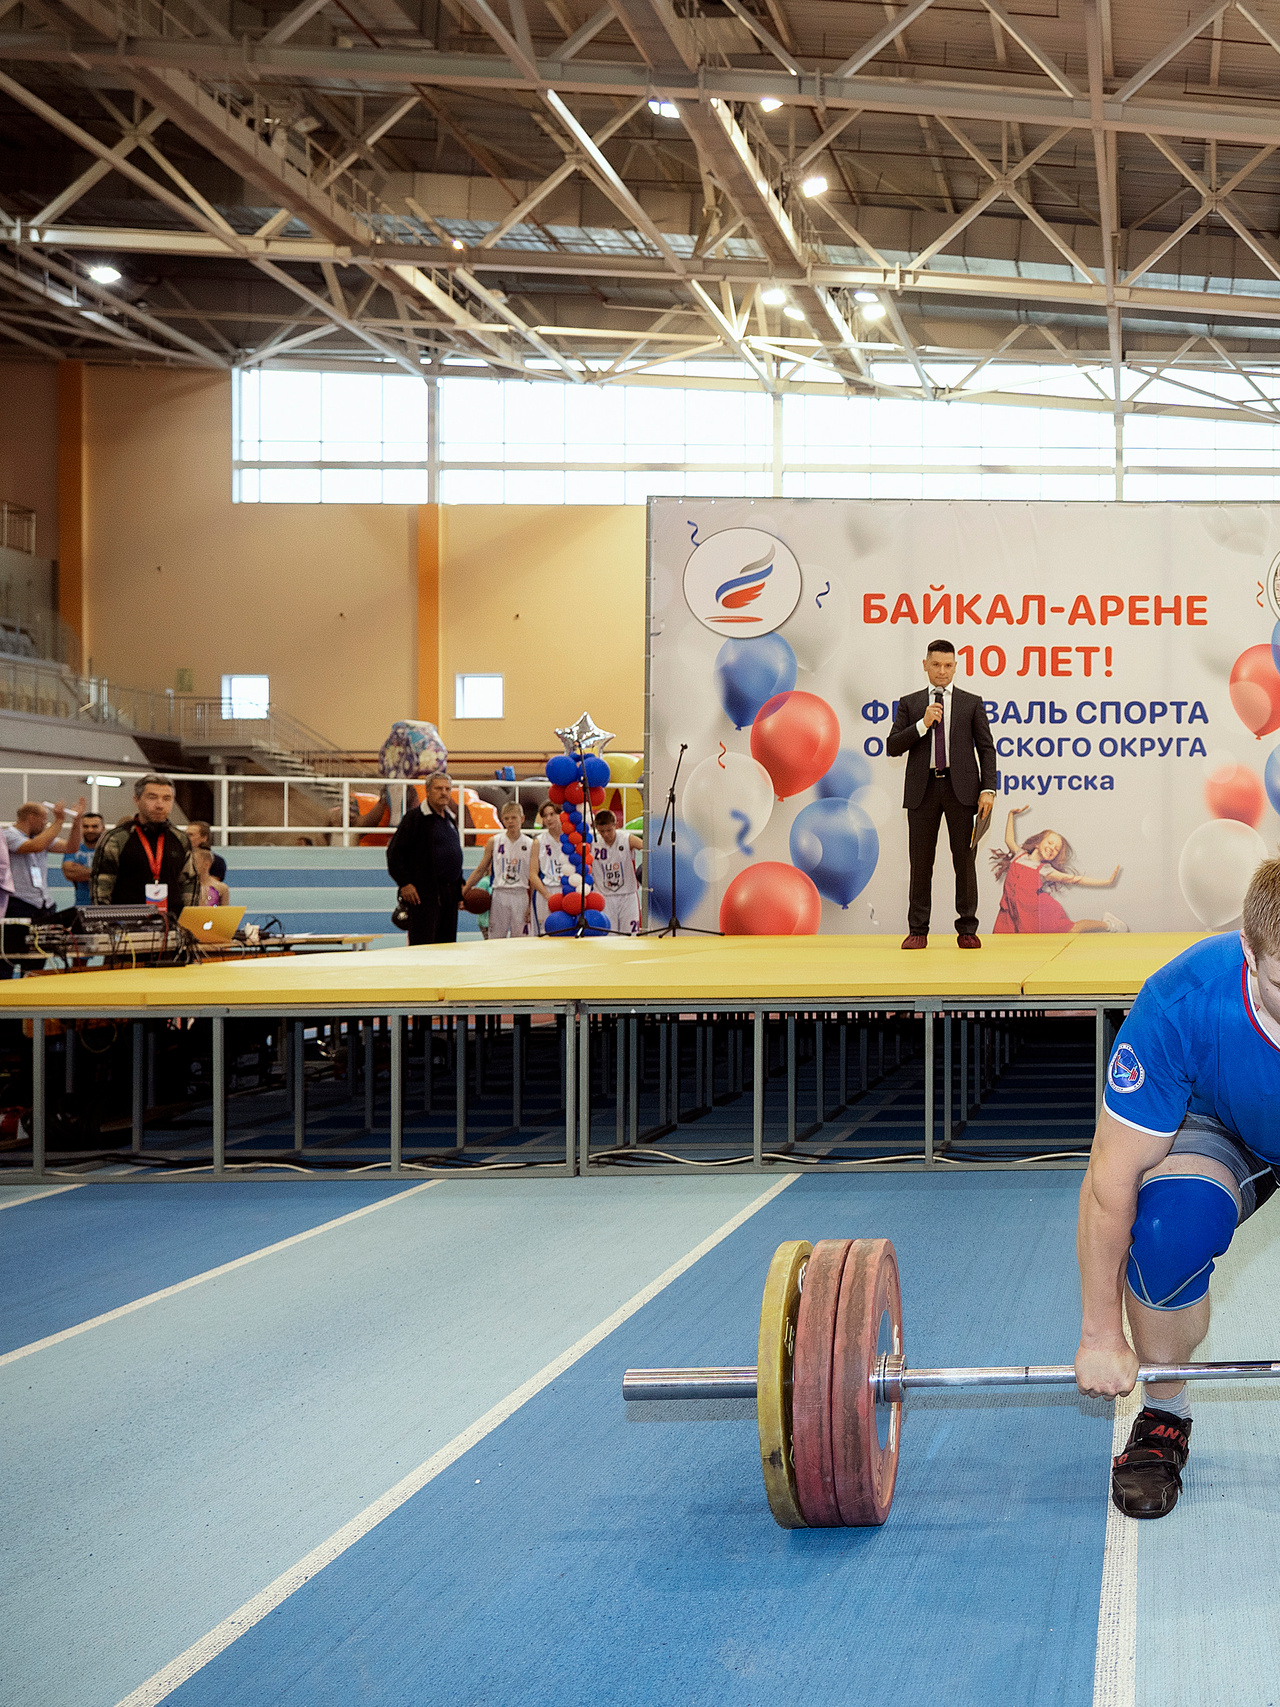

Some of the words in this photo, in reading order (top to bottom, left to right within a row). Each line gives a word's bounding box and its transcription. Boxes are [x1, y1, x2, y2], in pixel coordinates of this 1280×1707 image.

[862, 584, 1208, 626] БАЙКАЛ-АРЕНЕ
[957, 645, 1007, 677] 10
[1016, 645, 1113, 678] ЛЕТ!
[861, 699, 1067, 725] ФВАЛЬ
[1075, 700, 1209, 725] СПОРТА
[1098, 736, 1208, 758] ОКРУГА
[594, 847, 607, 860] 20
